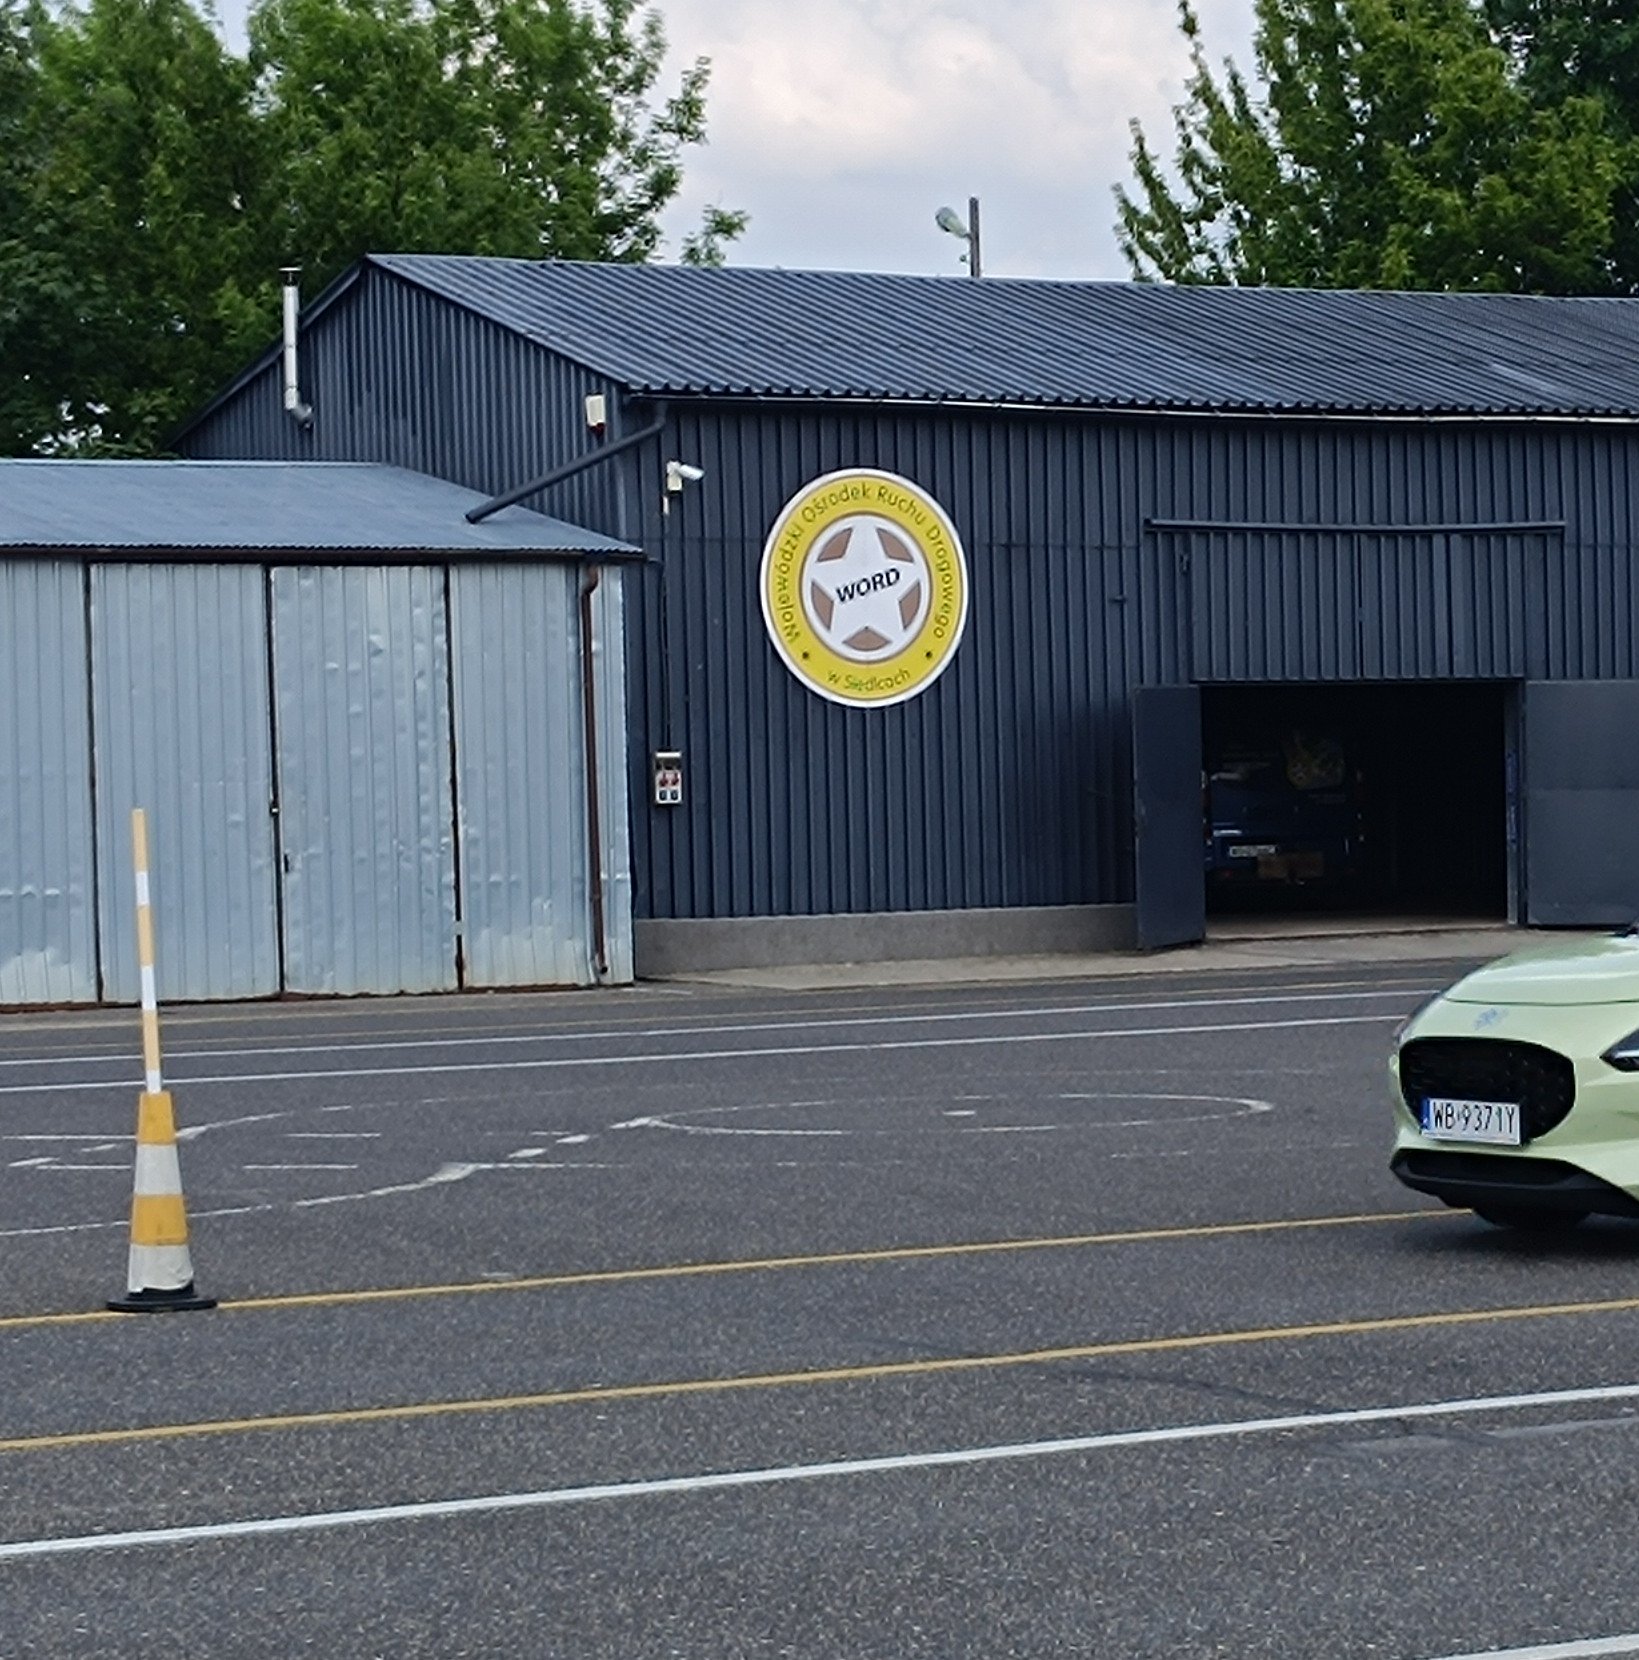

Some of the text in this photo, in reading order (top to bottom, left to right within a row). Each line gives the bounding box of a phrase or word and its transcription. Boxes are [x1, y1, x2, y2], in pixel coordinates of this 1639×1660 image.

[776, 482, 954, 644] Wojewódzki Ośrodek Ruchu Drogowego
[835, 567, 900, 603] WORD
[828, 668, 911, 692] w Siedlcach
